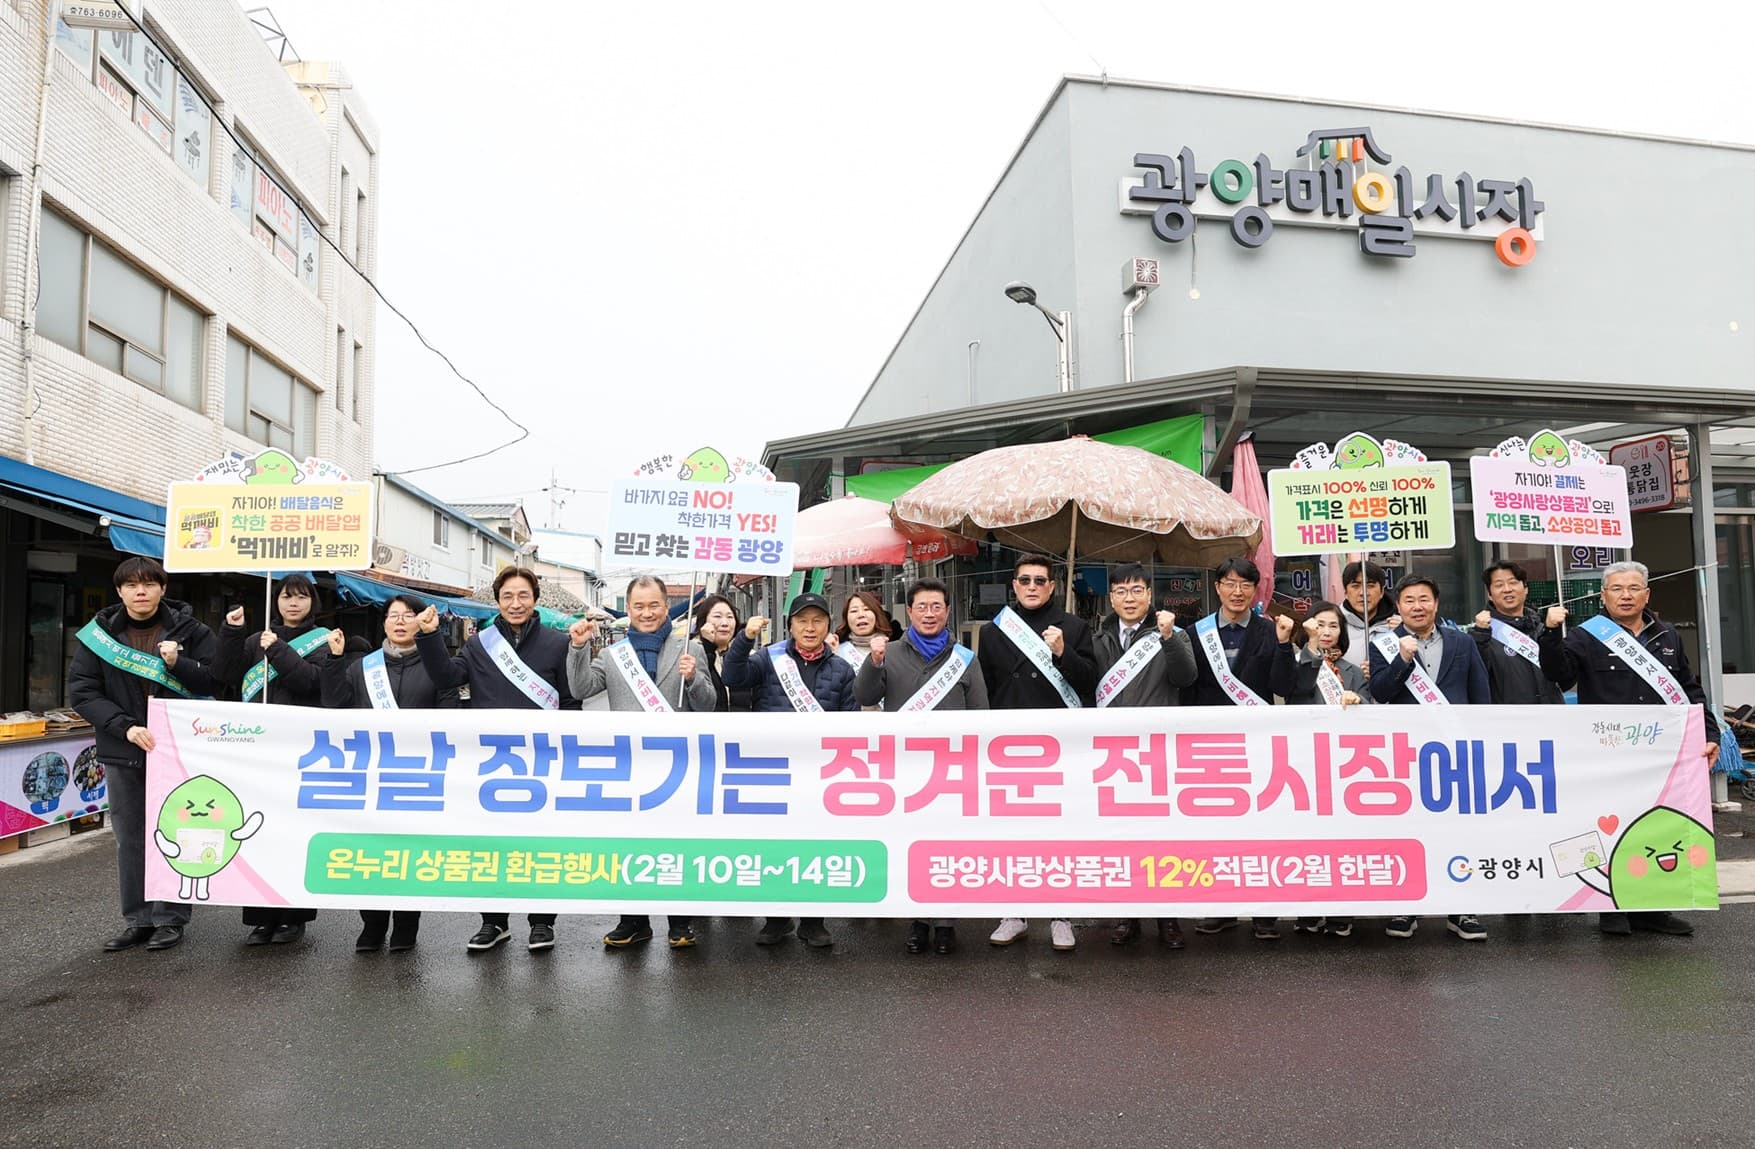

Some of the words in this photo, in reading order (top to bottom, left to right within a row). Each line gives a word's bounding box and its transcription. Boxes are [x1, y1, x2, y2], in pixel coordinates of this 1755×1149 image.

[258, 171, 292, 235] 피아노
[1129, 146, 1545, 267] 광양매일시장
[1300, 445, 1327, 470] 즐거운
[1384, 442, 1418, 459] 광양시
[1500, 439, 1525, 457] 신나는
[1570, 443, 1599, 461] 광양시
[305, 458, 341, 479] 광양시
[641, 454, 673, 475] 행복한
[733, 457, 766, 477] 광양시
[1285, 485, 1321, 496] 가격표시
[1323, 481, 1367, 495] 100%
[1370, 481, 1388, 492] 신뢰
[1391, 477, 1435, 491] 100%
[1515, 472, 1553, 488] 자기야!
[1555, 474, 1586, 490] 결제는
[232, 497, 276, 510] 자기야!
[280, 496, 344, 510] 배달음식은
[624, 489, 664, 506] 바가지
[667, 491, 689, 507] 요금
[693, 490, 734, 509] NO!
[1296, 500, 1343, 521] 가격은
[1348, 496, 1427, 519] 선명하게
[181, 517, 219, 531] 먹깨비
[232, 515, 266, 532] 착한
[270, 515, 301, 532] 공공
[305, 514, 361, 532] 배달앱
[677, 512, 731, 529] 착한가격
[737, 513, 777, 533] YES!
[1297, 523, 1348, 544] 거래는
[1354, 520, 1429, 542] 투명하게
[1486, 513, 1517, 530] 지역
[1519, 516, 1545, 534] 돕고,
[1547, 516, 1599, 535] 소상공인
[1601, 520, 1622, 536] 돕고
[326, 543, 360, 558] 알쥐?
[614, 532, 650, 556] 믿고
[656, 534, 689, 558] 찾는
[694, 536, 733, 561] 감동
[738, 538, 784, 564] 광양
[1126, 634, 1159, 669] 광양에서
[1615, 637, 1658, 675] 광양에서
[1658, 675, 1685, 704] 소비해
[192, 717, 265, 736] Sunshine
[1623, 721, 1664, 746] 광양
[297, 730, 456, 812] 설날
[478, 732, 791, 815] 장보기는
[820, 735, 1063, 817] 정겨운
[1093, 733, 1557, 817] 전통시장에서
[326, 849, 410, 881] 온누리
[415, 850, 498, 882] 상품권
[505, 850, 684, 887] 환급행사(2월
[693, 854, 866, 888] 10일~14일)
[929, 855, 1131, 888] 광양사랑상품권
[1139, 854, 1332, 888] 12%적립(2월
[1339, 854, 1406, 888] 한달)
[1478, 857, 1544, 880] 광양시
